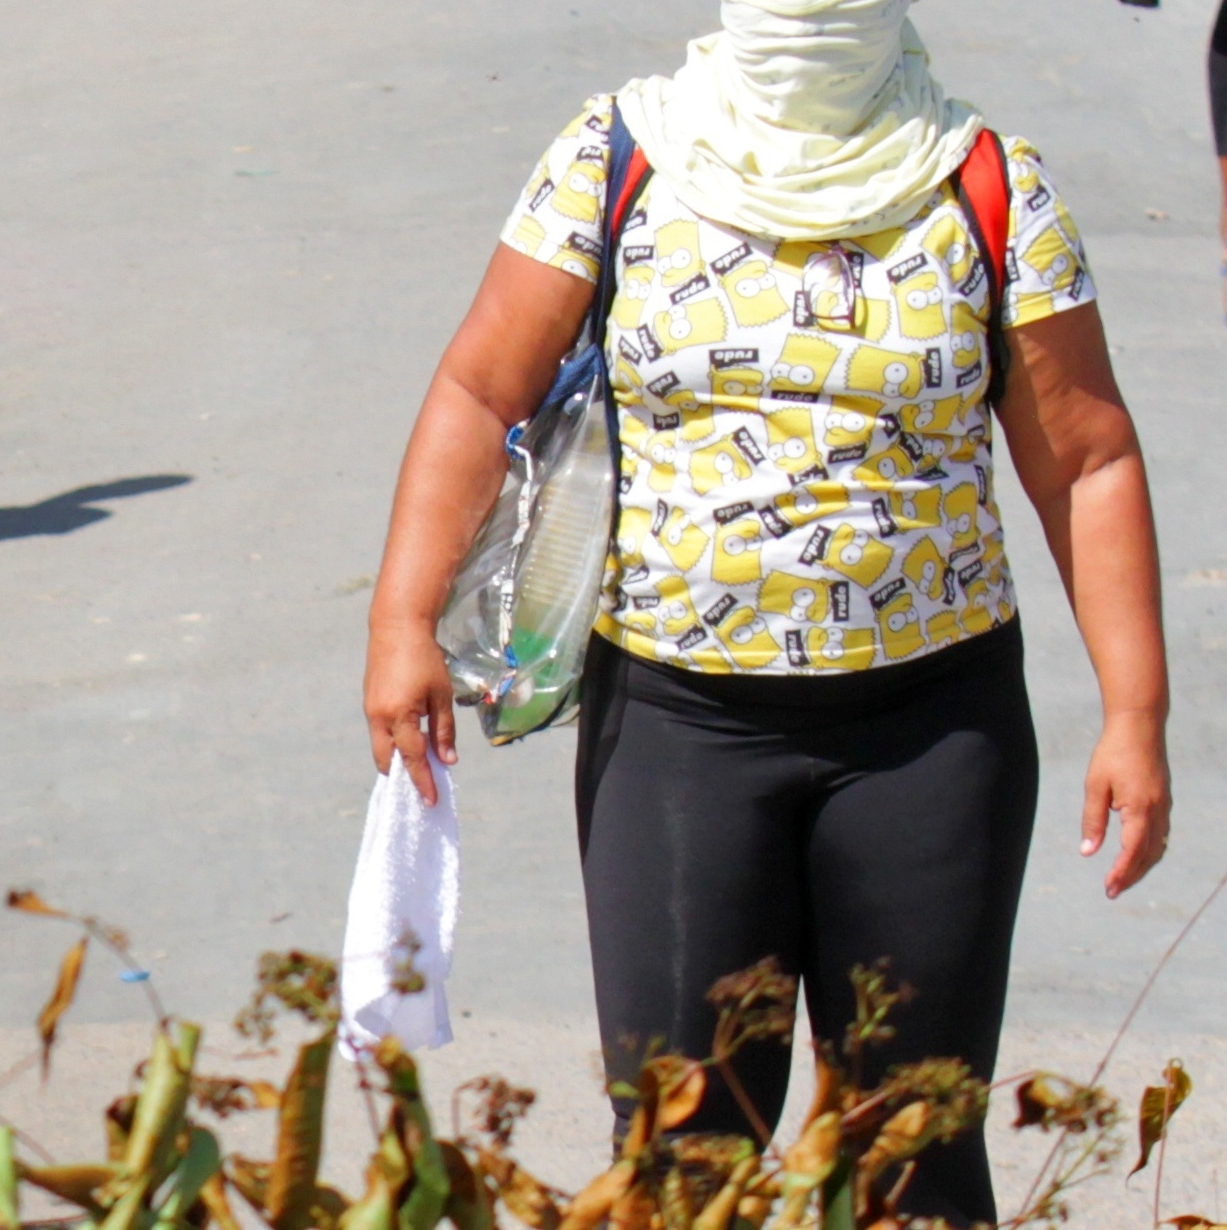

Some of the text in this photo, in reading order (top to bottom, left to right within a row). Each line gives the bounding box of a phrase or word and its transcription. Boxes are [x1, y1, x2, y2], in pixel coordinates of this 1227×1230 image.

[714, 244, 747, 270] rude
[891, 255, 923, 277] rude
[674, 279, 707, 303] rude
[963, 262, 985, 294] rude
[795, 293, 810, 325] rude
[637, 327, 656, 360] rude
[713, 350, 755, 364] rude
[928, 350, 940, 385] rude
[776, 392, 814, 404] rude
[738, 430, 765, 461] rude
[831, 448, 864, 463] rude
[717, 502, 750, 519] rude
[761, 510, 785, 536] rude
[873, 501, 891, 534] rude
[802, 527, 826, 562] rude
[835, 584, 848, 619] rude
[873, 579, 903, 603] rude
[706, 594, 732, 622] rude
[680, 629, 703, 648] rude
[786, 633, 802, 663] rude
